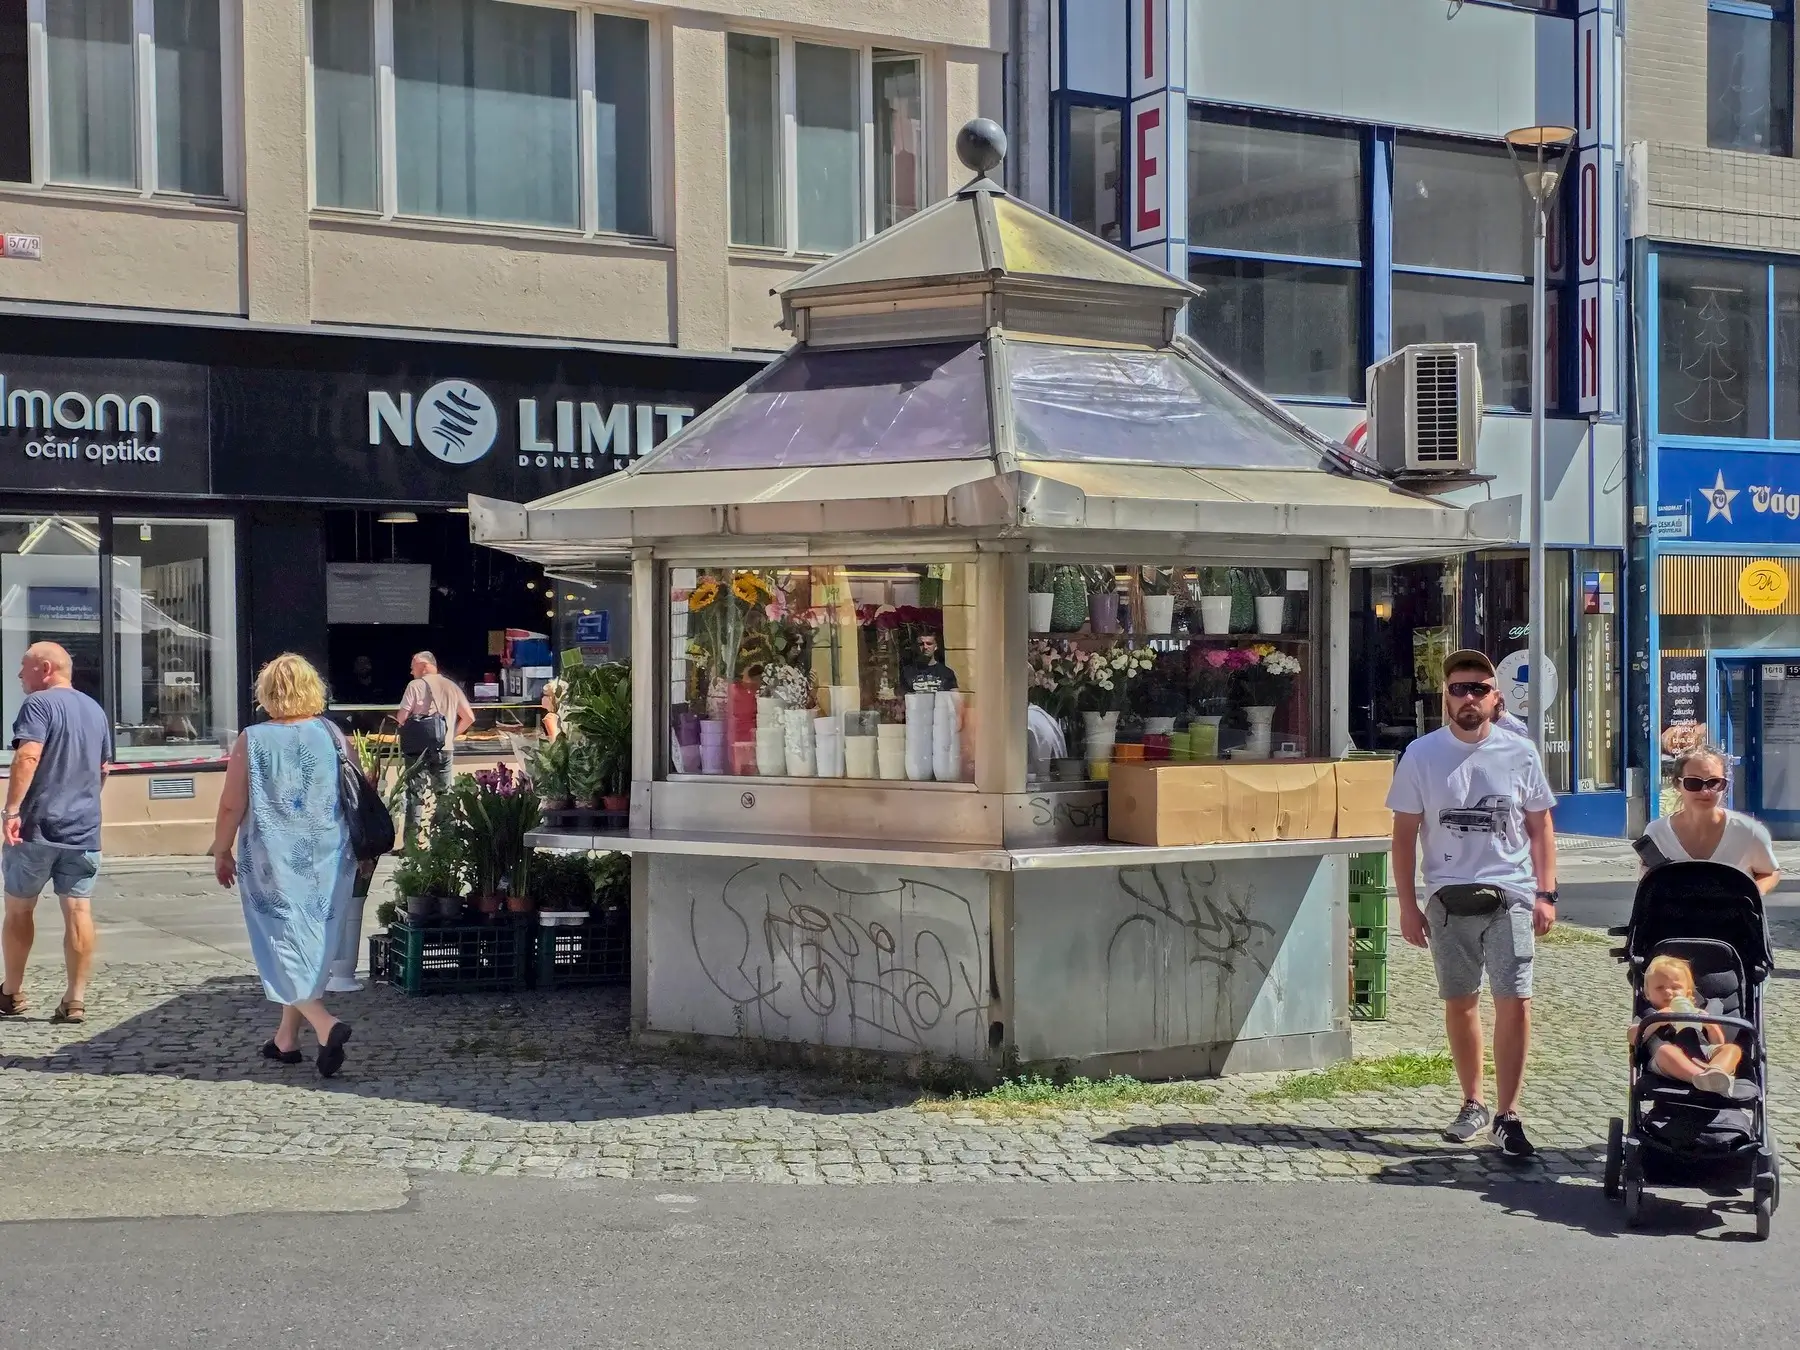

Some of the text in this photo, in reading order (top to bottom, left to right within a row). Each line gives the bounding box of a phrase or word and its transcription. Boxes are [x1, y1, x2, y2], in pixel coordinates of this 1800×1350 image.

[9, 237, 39, 249] 5/7/9
[25, 436, 78, 459] oční
[85, 438, 161, 465] optika
[518, 453, 595, 469] DÖNER
[1670, 670, 1698, 681] Denně
[1667, 682, 1700, 693] čerstvé
[1581, 780, 1590, 790] 20
